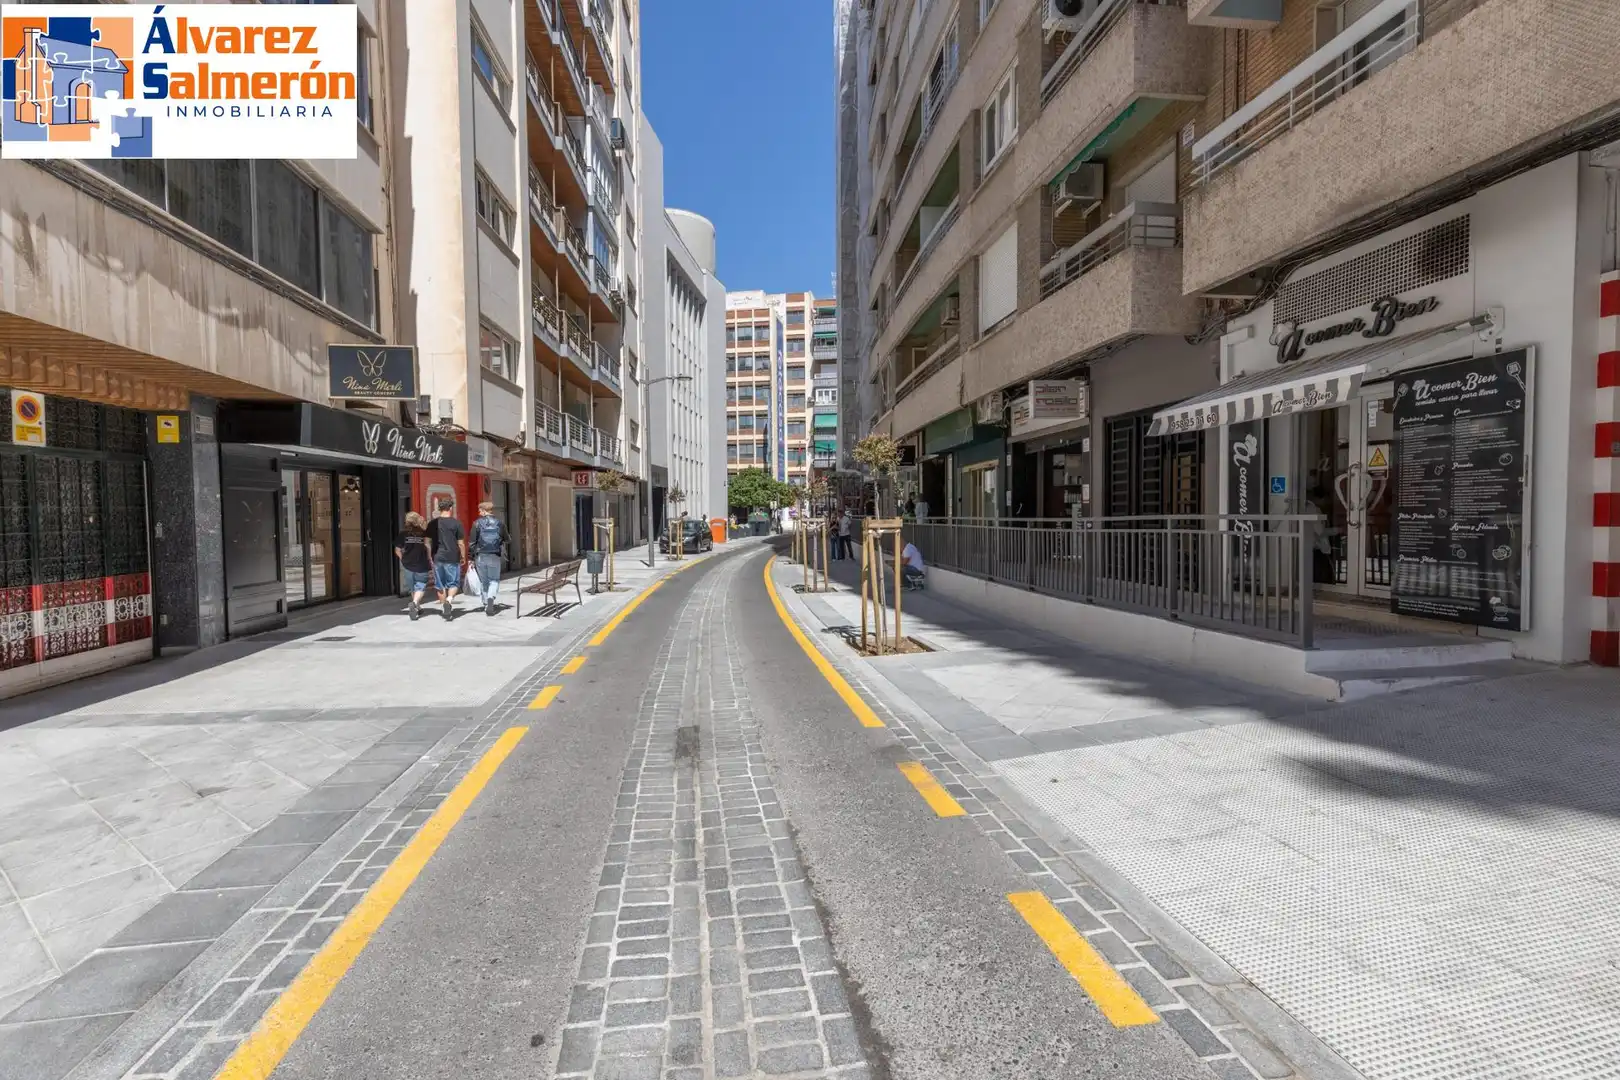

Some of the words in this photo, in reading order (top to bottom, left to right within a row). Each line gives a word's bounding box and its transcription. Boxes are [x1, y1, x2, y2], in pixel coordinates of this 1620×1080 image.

[1304, 317, 1367, 346] comer
[1362, 296, 1441, 339] Bien
[1431, 379, 1463, 393] comer
[1461, 372, 1499, 391] Bien
[1459, 391, 1479, 402] para
[1171, 419, 1184, 430] 958
[1206, 412, 1217, 424] 60
[387, 427, 417, 459] Nina
